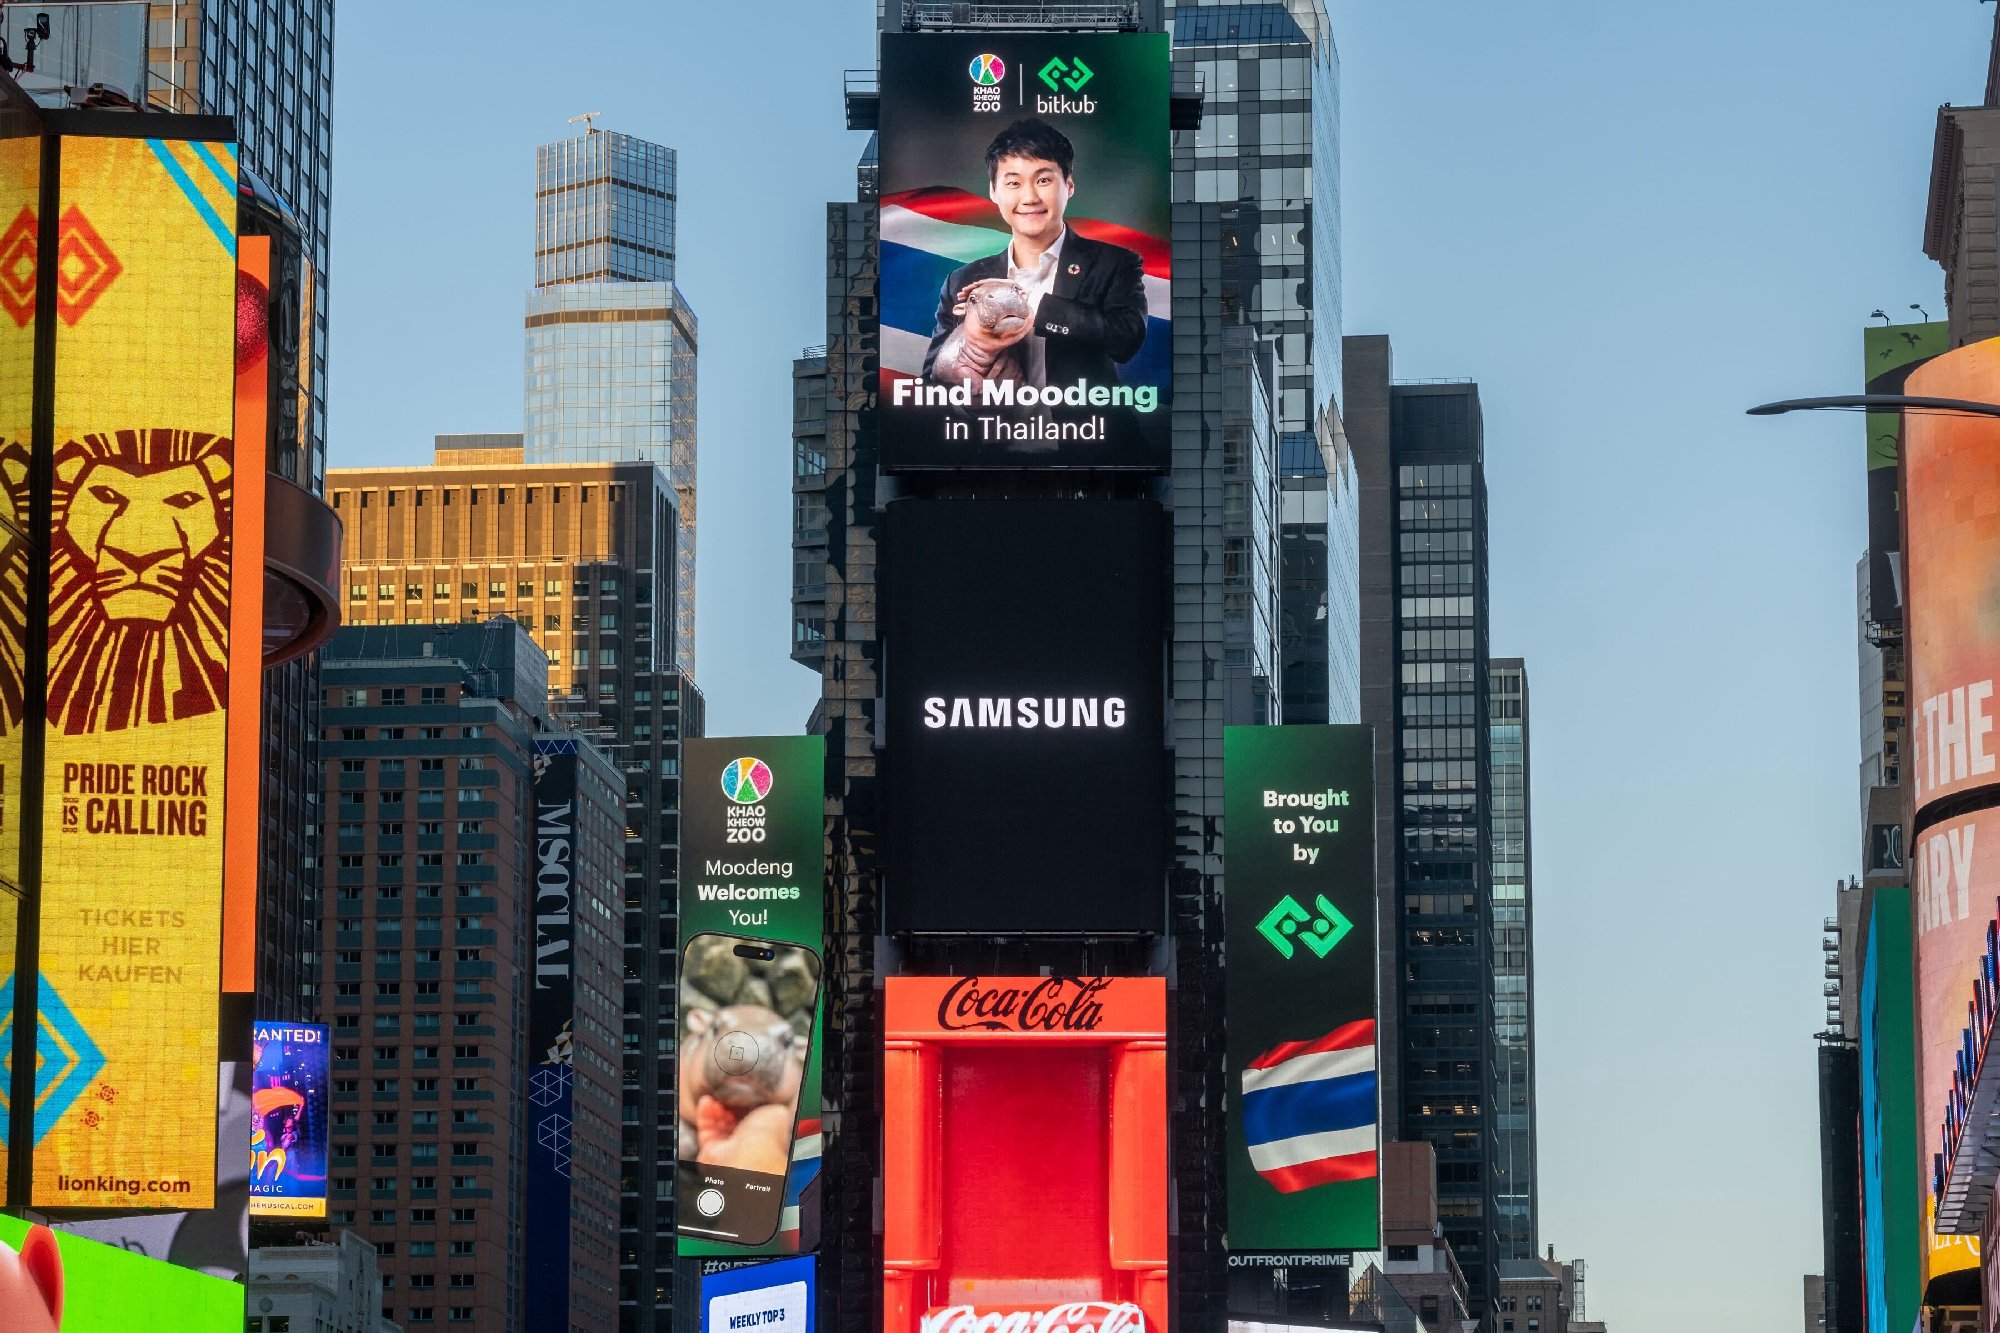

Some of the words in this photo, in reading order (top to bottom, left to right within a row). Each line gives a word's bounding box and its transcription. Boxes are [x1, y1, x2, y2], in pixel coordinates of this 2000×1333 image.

[973, 86, 1001, 95] KHAO
[973, 102, 1001, 112] ZOO
[1037, 94, 1095, 114] bitkub
[892, 378, 972, 406] Find
[982, 378, 1158, 413] Moodeng
[944, 416, 968, 440] in
[978, 415, 1105, 440] Thailand!
[923, 697, 1126, 729] SAMSUNG
[1923, 679, 1996, 791] THE
[63, 762, 136, 795] PRIDE
[142, 764, 208, 797] ROCK
[1263, 788, 1349, 811] Brought
[62, 804, 78, 826] IS
[86, 797, 208, 837] CALLING
[727, 805, 766, 817] KHAO
[727, 818, 766, 827] KHEOW
[1273, 818, 1296, 834] to
[1298, 815, 1339, 834] You
[726, 828, 766, 844] ZOO
[1293, 843, 1320, 865] by
[705, 858, 793, 879] Moodeng
[698, 883, 801, 901] Welcomes
[79, 908, 185, 928] TICKETS
[729, 908, 769, 926] You!
[102, 935, 161, 956] HIER
[78, 964, 184, 984] KAUFEN
[937, 976, 1114, 1032] Coca-Cola
[57, 1174, 191, 1195] lionking.com
[705, 1176, 725, 1186] Photo
[745, 1182, 771, 1193] Portrait
[729, 1311, 761, 1330] WEEKLY
[762, 1308, 779, 1325] TOP
[779, 1307, 785, 1322] 3
